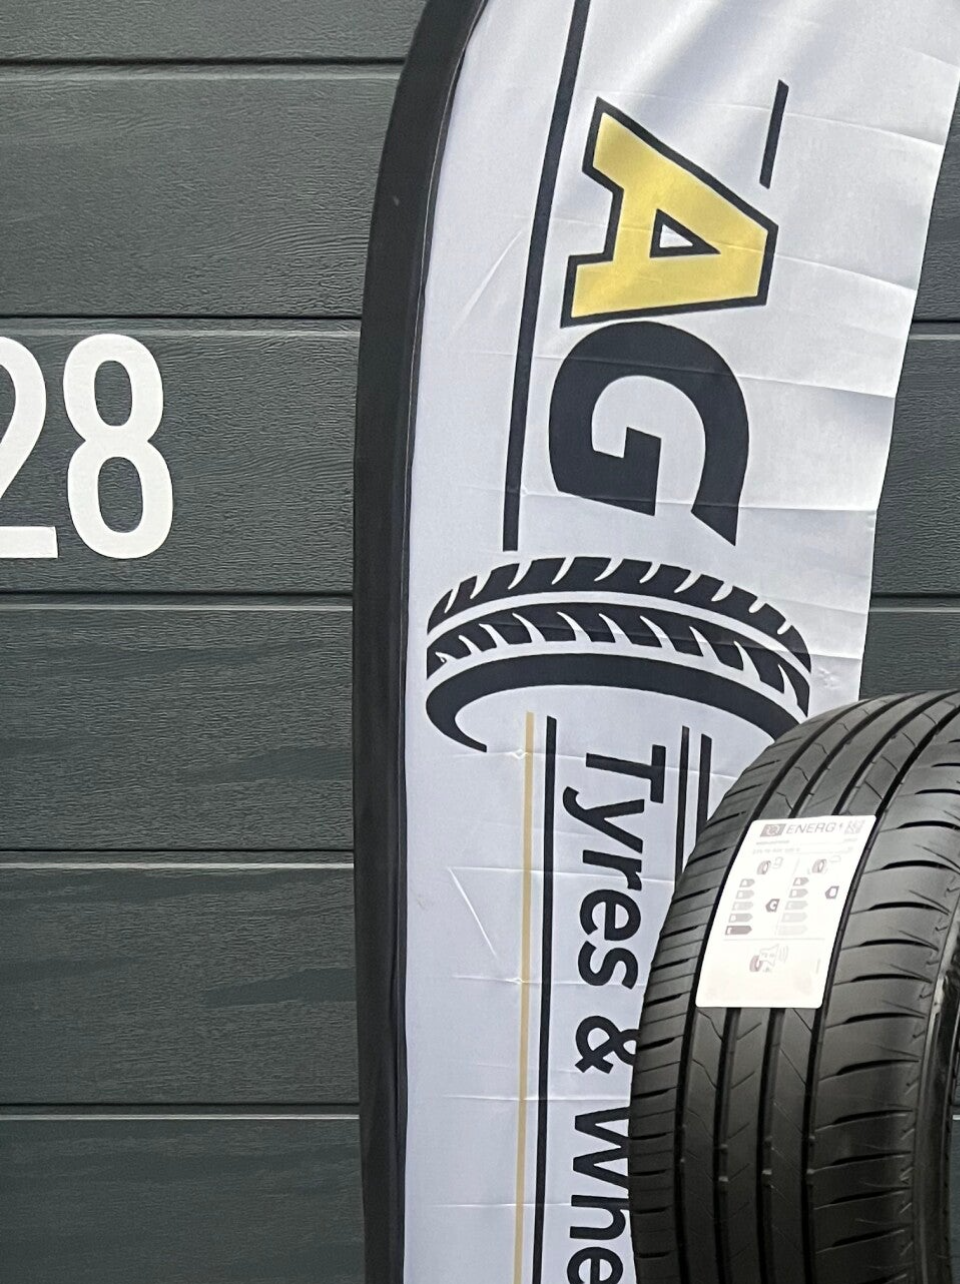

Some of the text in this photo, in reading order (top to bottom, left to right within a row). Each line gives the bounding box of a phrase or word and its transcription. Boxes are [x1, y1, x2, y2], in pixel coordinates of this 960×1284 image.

[549, 96, 779, 546] AG
[0, 333, 173, 559] 28
[563, 744, 666, 991] Tyres
[786, 822, 836, 834] ENERG
[573, 1014, 641, 1076] &
